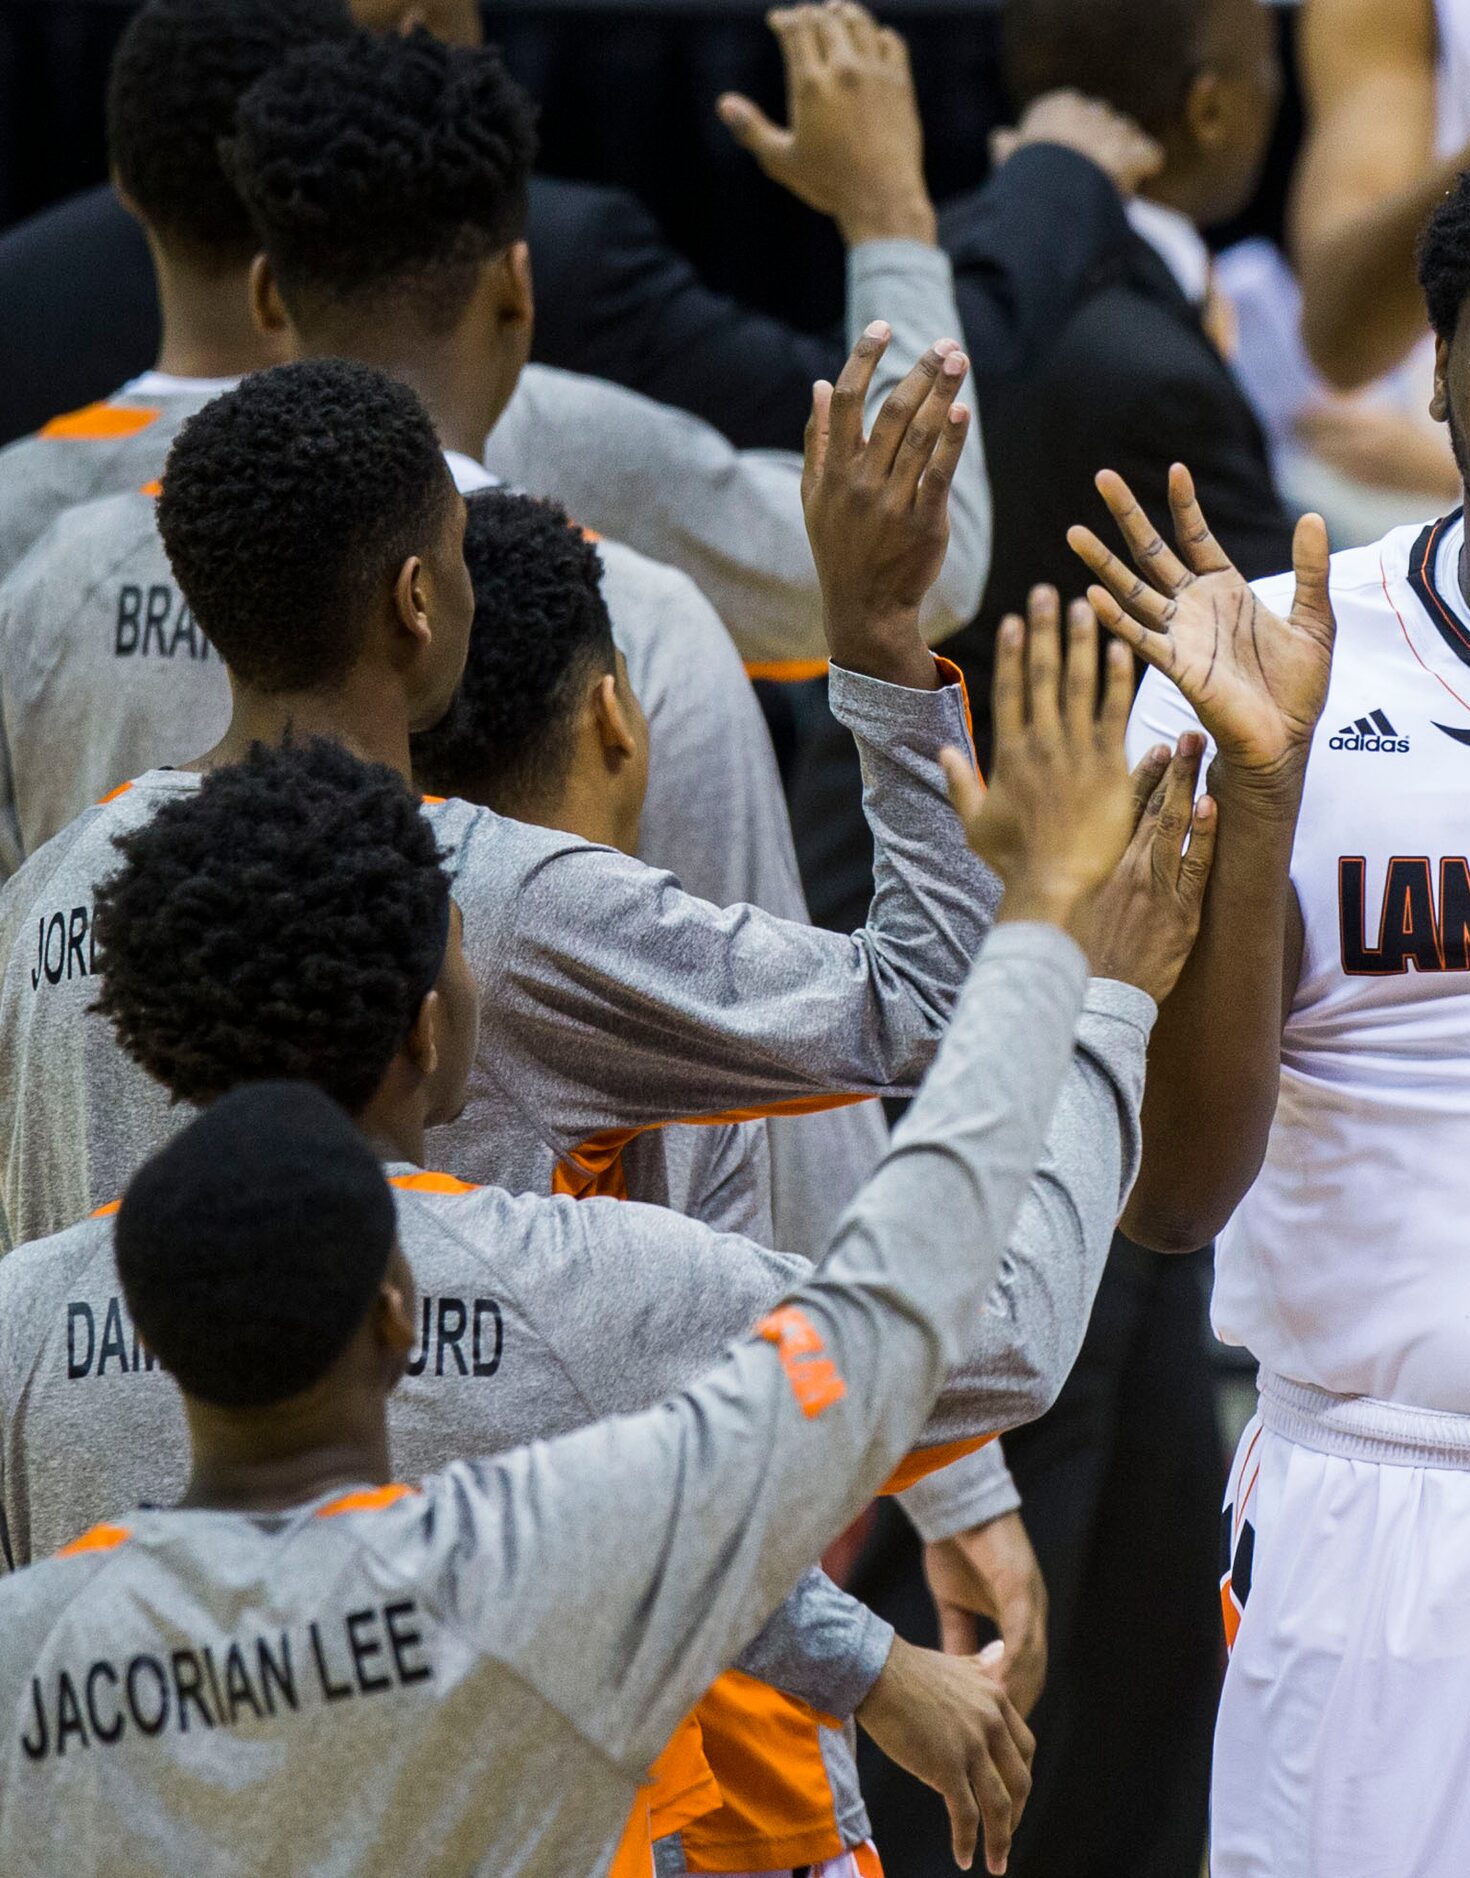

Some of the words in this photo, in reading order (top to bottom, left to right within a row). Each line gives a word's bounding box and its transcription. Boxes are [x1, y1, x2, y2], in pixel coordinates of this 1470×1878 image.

[115, 583, 216, 661] BRA
[1329, 733, 1411, 754] adidas
[21, 1632, 299, 1761] JACORIAN
[309, 1600, 433, 1701] LEE
